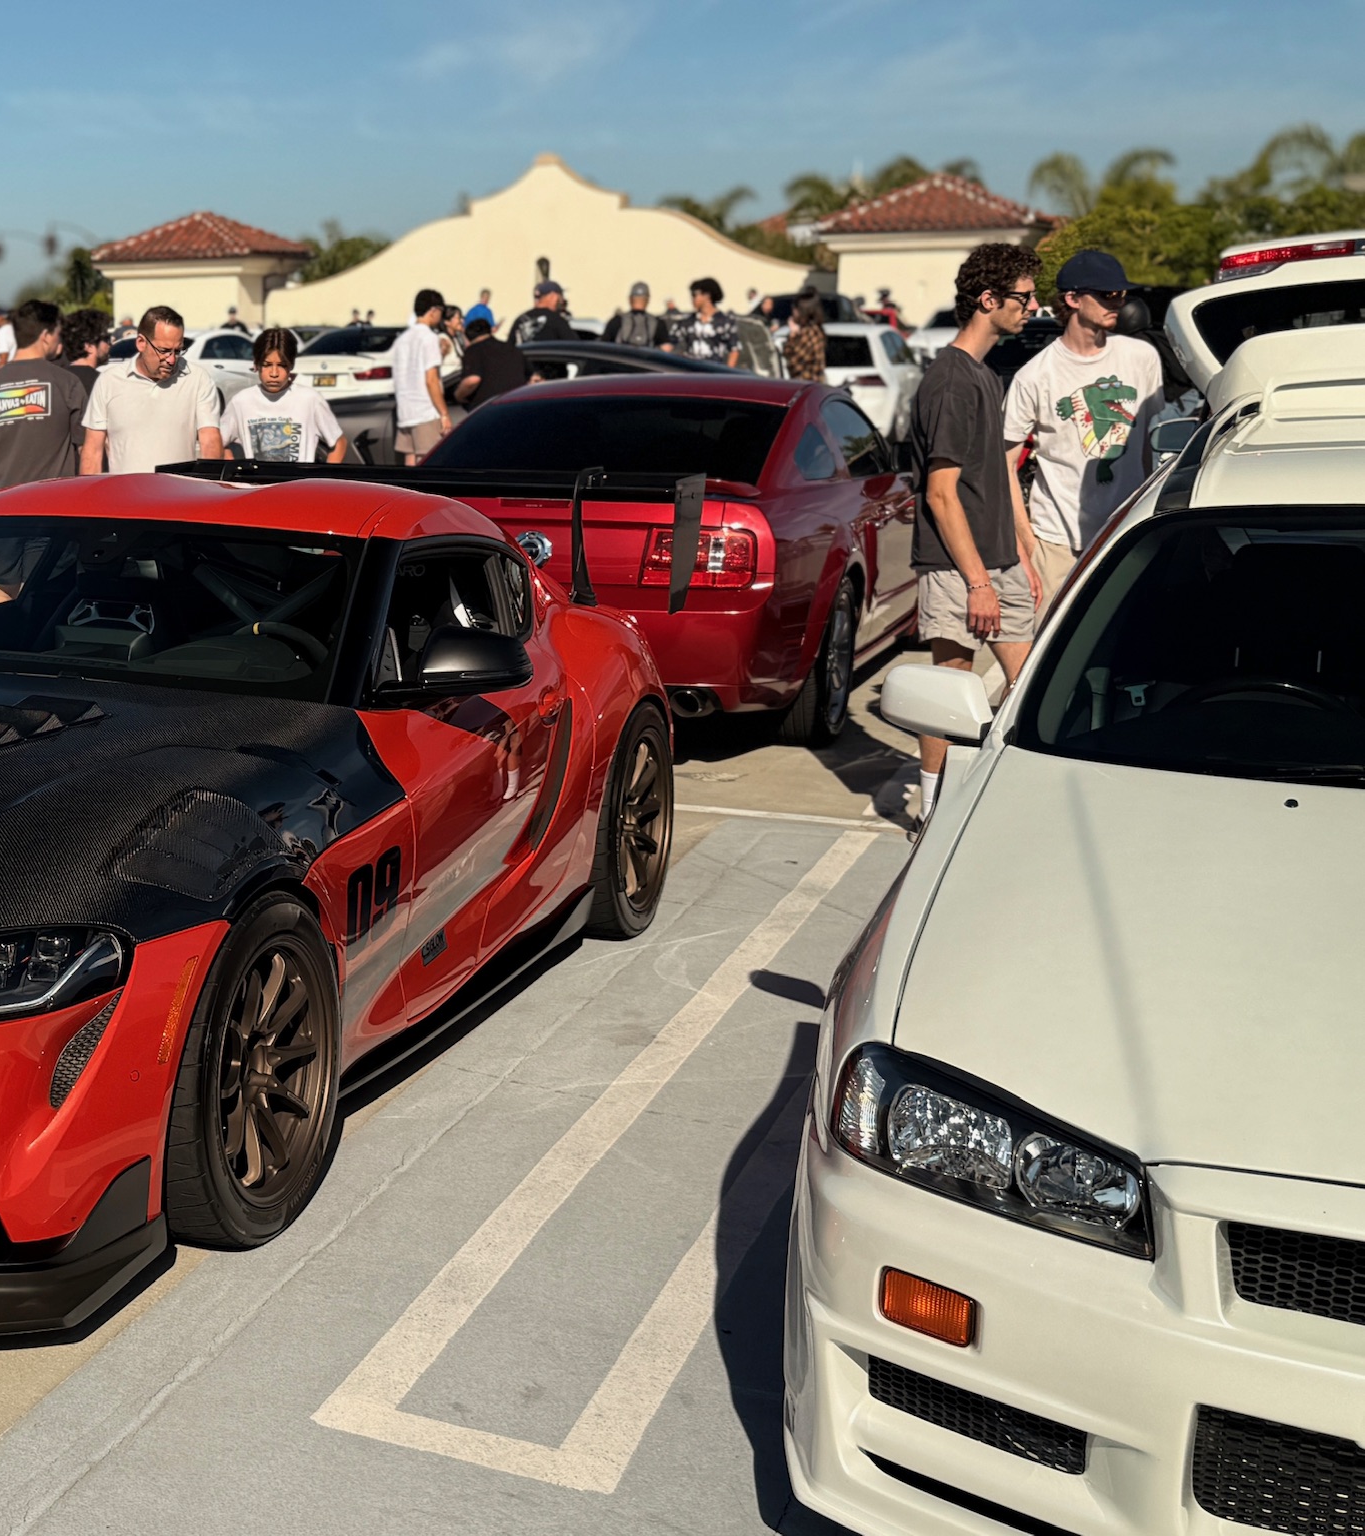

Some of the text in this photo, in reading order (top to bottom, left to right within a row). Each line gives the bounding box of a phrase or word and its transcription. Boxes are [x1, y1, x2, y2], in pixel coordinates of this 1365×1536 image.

[25, 390, 46, 408] KATIN
[288, 423, 303, 462] MoMA
[346, 844, 402, 962] 09
